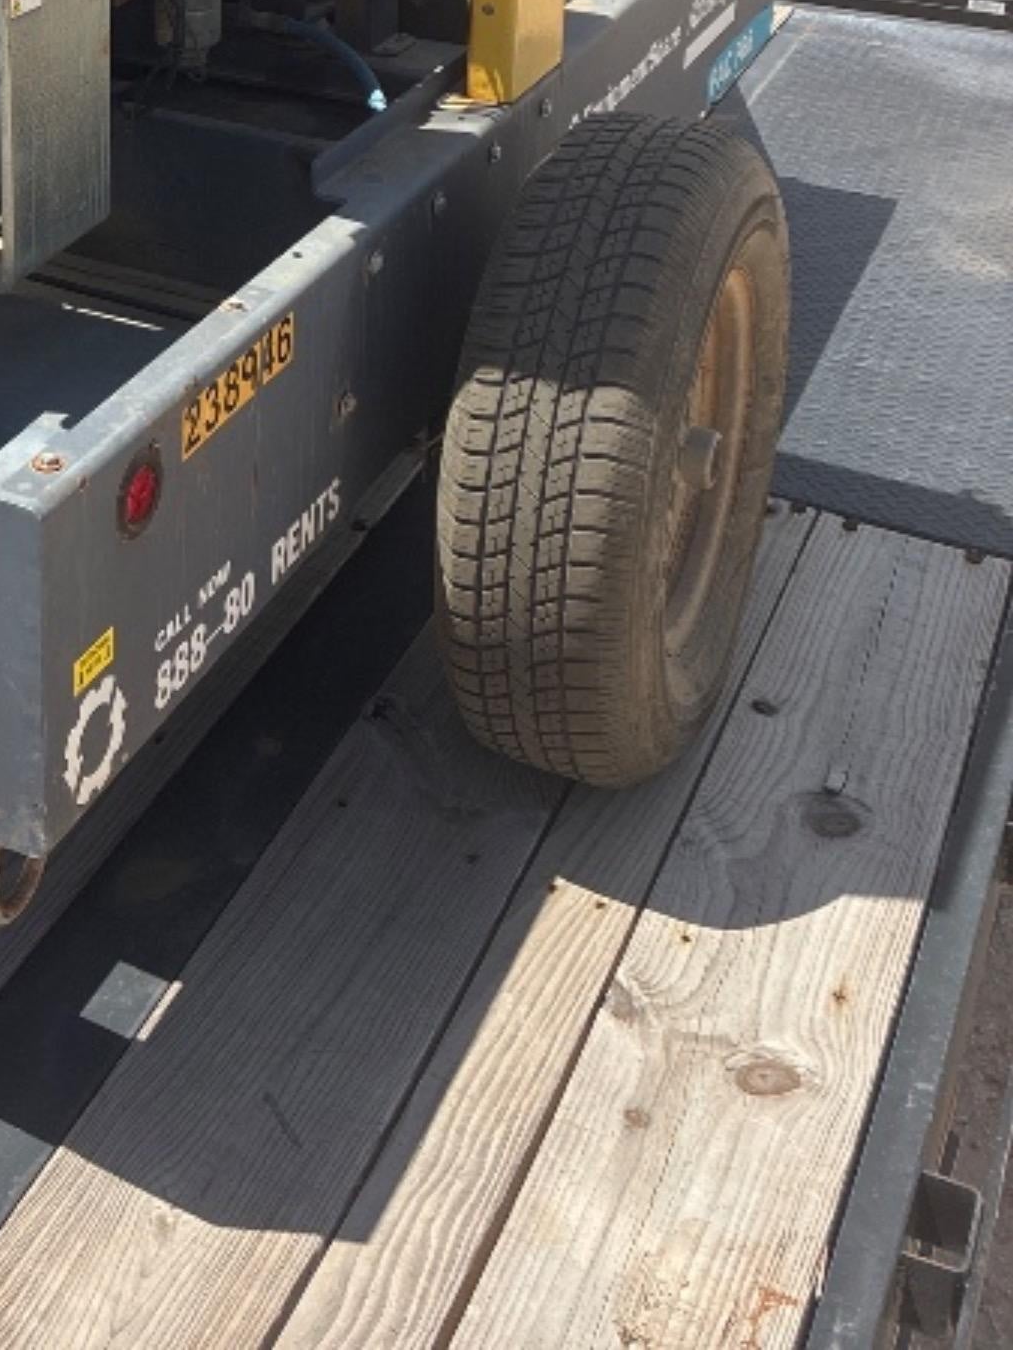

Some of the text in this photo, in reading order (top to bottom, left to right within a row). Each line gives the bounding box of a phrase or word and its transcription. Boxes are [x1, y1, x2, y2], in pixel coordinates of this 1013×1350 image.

[184, 317, 291, 453] 238946
[271, 476, 340, 586] RENTS
[154, 604, 192, 652] CALL
